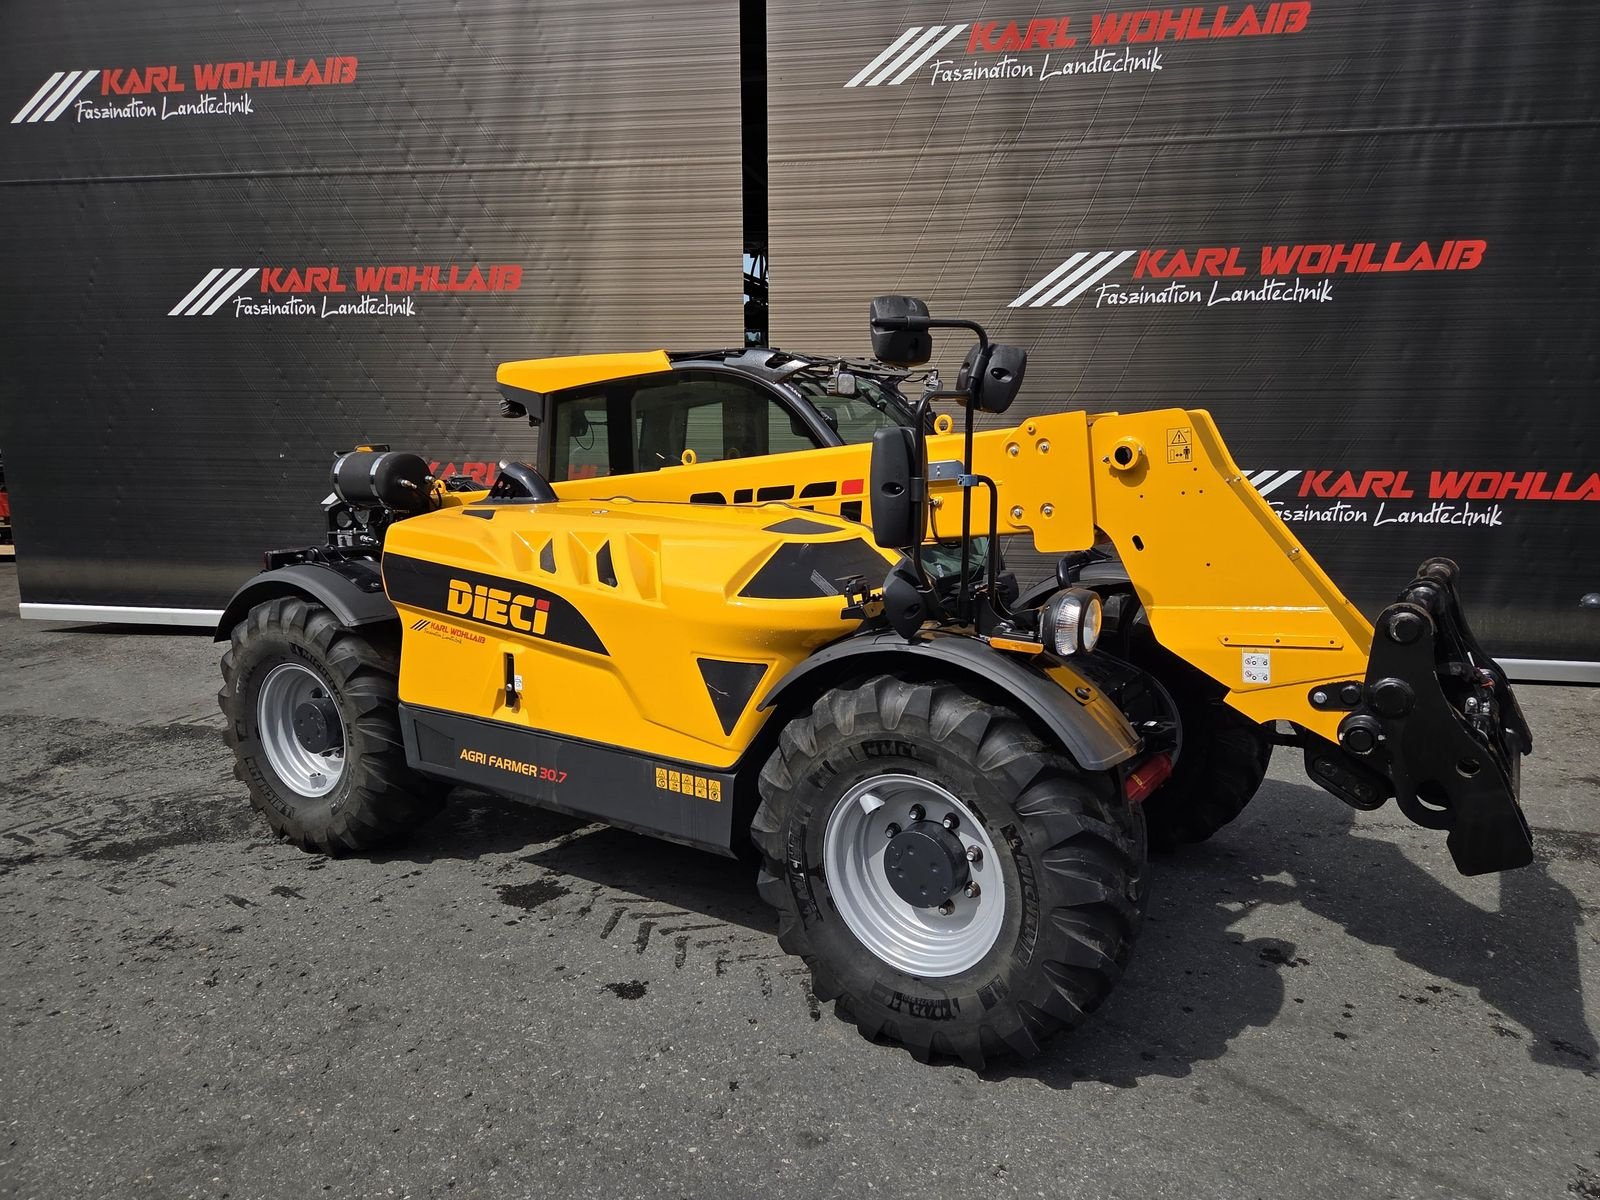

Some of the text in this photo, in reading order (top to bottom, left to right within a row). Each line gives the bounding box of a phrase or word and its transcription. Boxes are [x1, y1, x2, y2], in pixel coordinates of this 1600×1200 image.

[966, 16, 1077, 53] KARL
[101, 66, 185, 96] KARL
[929, 47, 1163, 85] Faszination Landtechnik
[75, 93, 254, 123] Faszination Landtechnik
[1133, 247, 1246, 279] KARL
[261, 267, 346, 293] KARL
[1096, 278, 1333, 308] Faszination Landtechnik
[233, 294, 415, 318] Faszination Landtechnik
[1298, 470, 1415, 498] KARL
[1373, 501, 1503, 527] Landtechnik
[431, 622, 448, 634] KARL
[460, 748, 568, 784] AGRI FARMER 30.7
